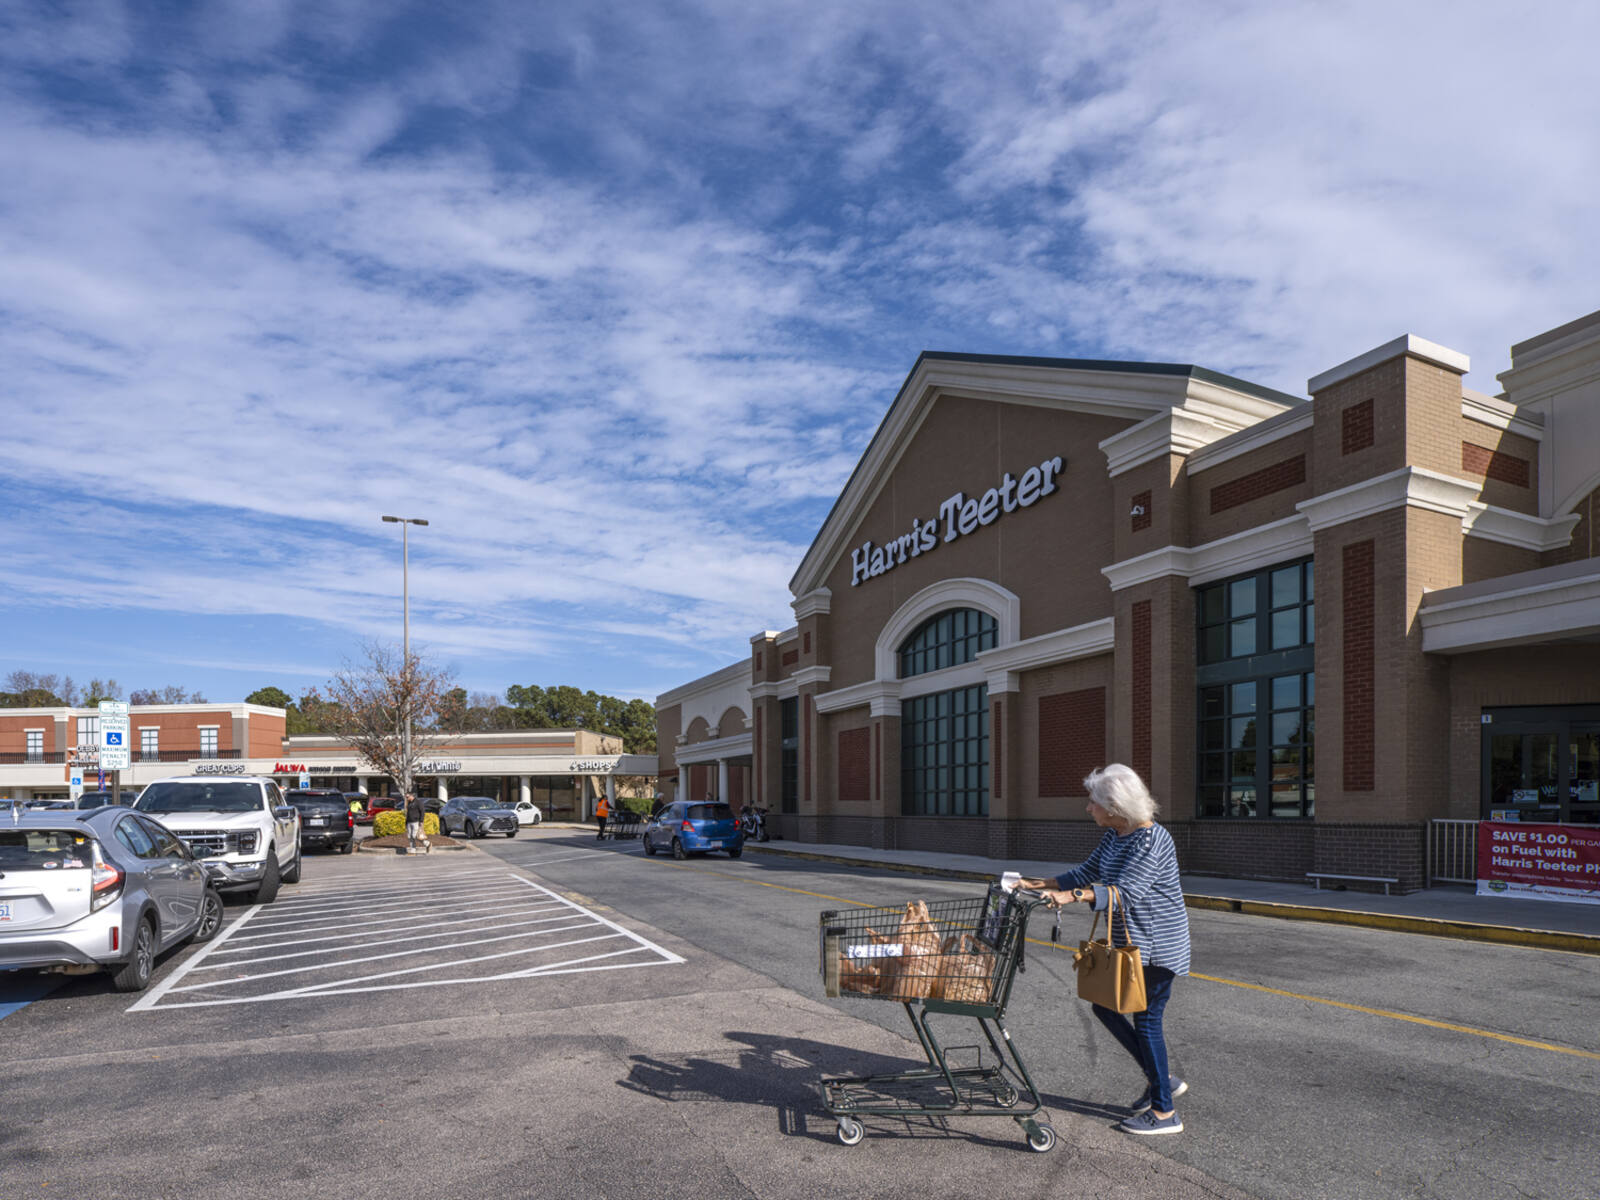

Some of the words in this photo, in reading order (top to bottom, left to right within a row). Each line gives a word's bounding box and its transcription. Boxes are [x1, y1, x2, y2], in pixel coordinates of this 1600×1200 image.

[851, 518, 938, 586] Harris
[939, 456, 1064, 543] Teeter
[196, 764, 222, 774] GREAT
[223, 764, 245, 774] CLIPS
[579, 759, 611, 769] SHOPS
[1492, 831, 1527, 842] SAVE
[1529, 832, 1568, 845] $1.00
[1570, 838, 1585, 846] PER
[1491, 845, 1509, 853] on
[1511, 844, 1542, 856] Fuel
[1544, 847, 1577, 859] with
[1491, 855, 1533, 869] Harris
[1535, 859, 1582, 873] Teeter
